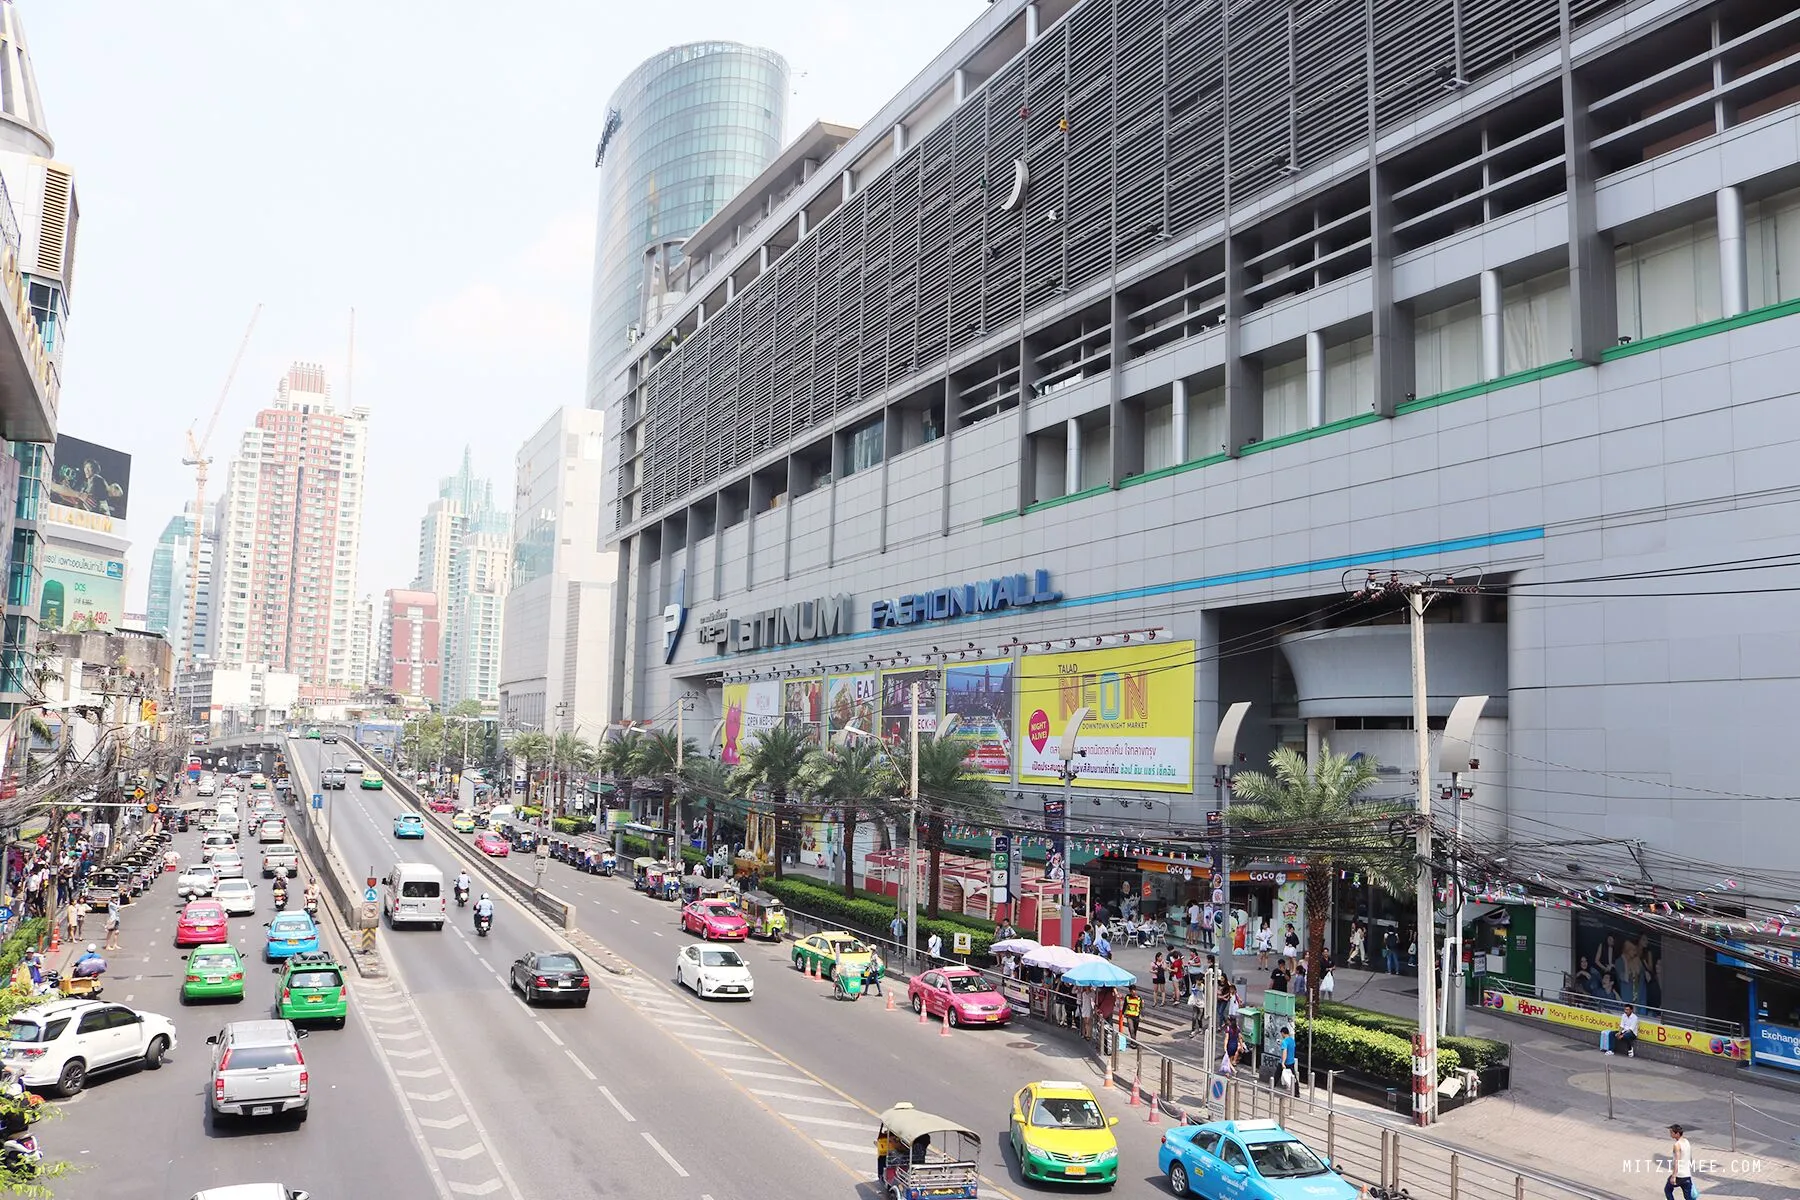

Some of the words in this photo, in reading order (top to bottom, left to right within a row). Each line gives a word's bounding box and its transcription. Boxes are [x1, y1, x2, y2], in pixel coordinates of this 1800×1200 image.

[871, 582, 975, 629] FASHION
[975, 568, 1063, 613] MALL
[1058, 664, 1078, 673] TALAD
[1059, 670, 1148, 721] NEON
[1031, 722, 1046, 732] NIGHT
[1549, 1008, 1566, 1020] Many
[1568, 1012, 1579, 1022] Fun
[1585, 1015, 1613, 1028] Fabulous
[1658, 1026, 1666, 1042] B
[1761, 1029, 1800, 1046] Exchang
